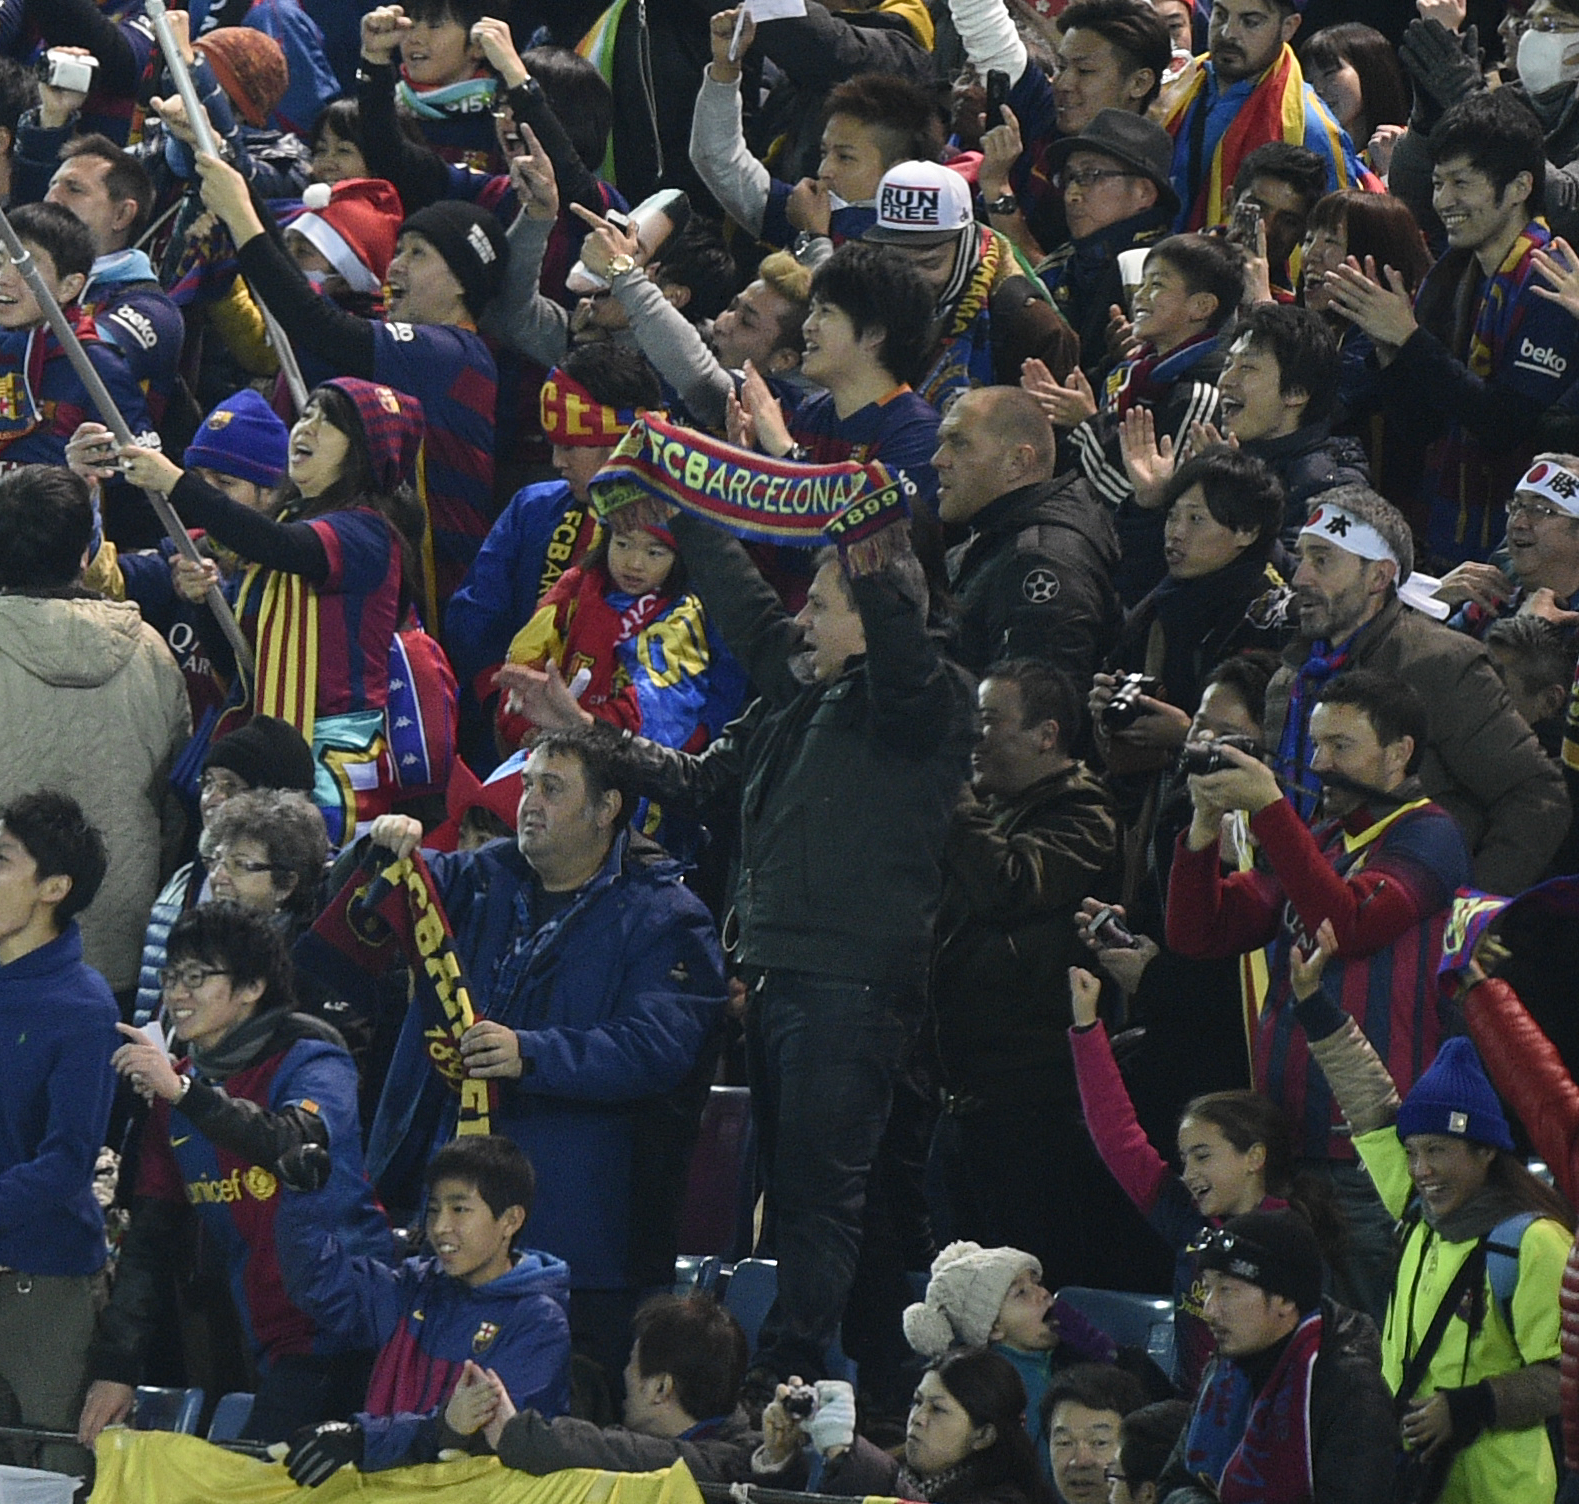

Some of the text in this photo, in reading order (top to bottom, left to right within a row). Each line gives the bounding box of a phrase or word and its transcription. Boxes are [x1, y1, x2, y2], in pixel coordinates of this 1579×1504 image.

[881, 188, 940, 210] RUN
[880, 205, 940, 224] FREE
[1519, 335, 1568, 372] beko
